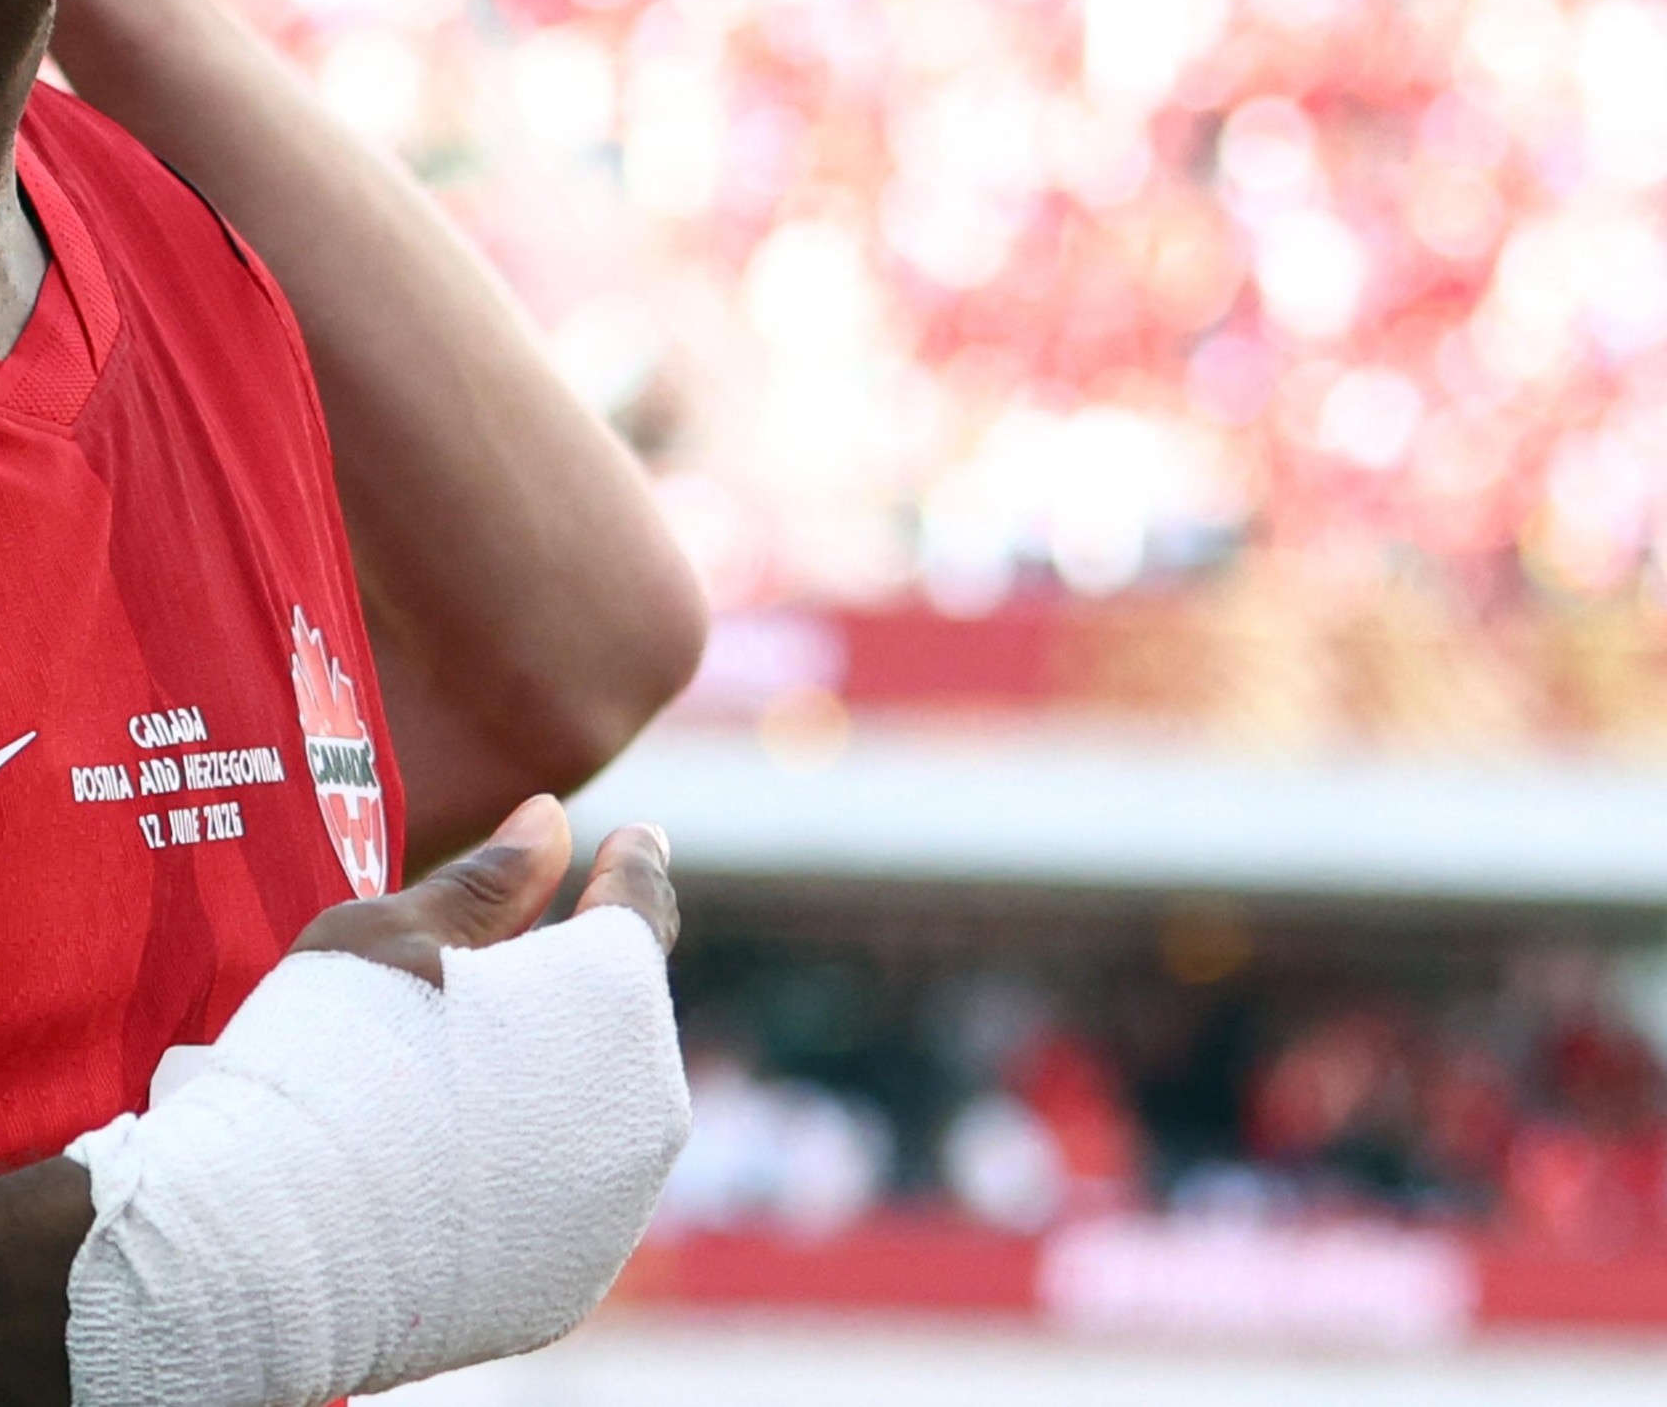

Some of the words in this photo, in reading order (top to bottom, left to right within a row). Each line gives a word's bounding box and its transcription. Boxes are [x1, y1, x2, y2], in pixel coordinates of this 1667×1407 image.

[129, 706, 208, 749] CANADA
[71, 764, 134, 802] BOSNIA
[139, 758, 180, 795] AND
[182, 747, 285, 790] HERZEGOVINA
[308, 741, 378, 789] CANADA
[139, 814, 165, 849] 12
[168, 807, 201, 845] JUNE
[203, 802, 244, 841] 2026
